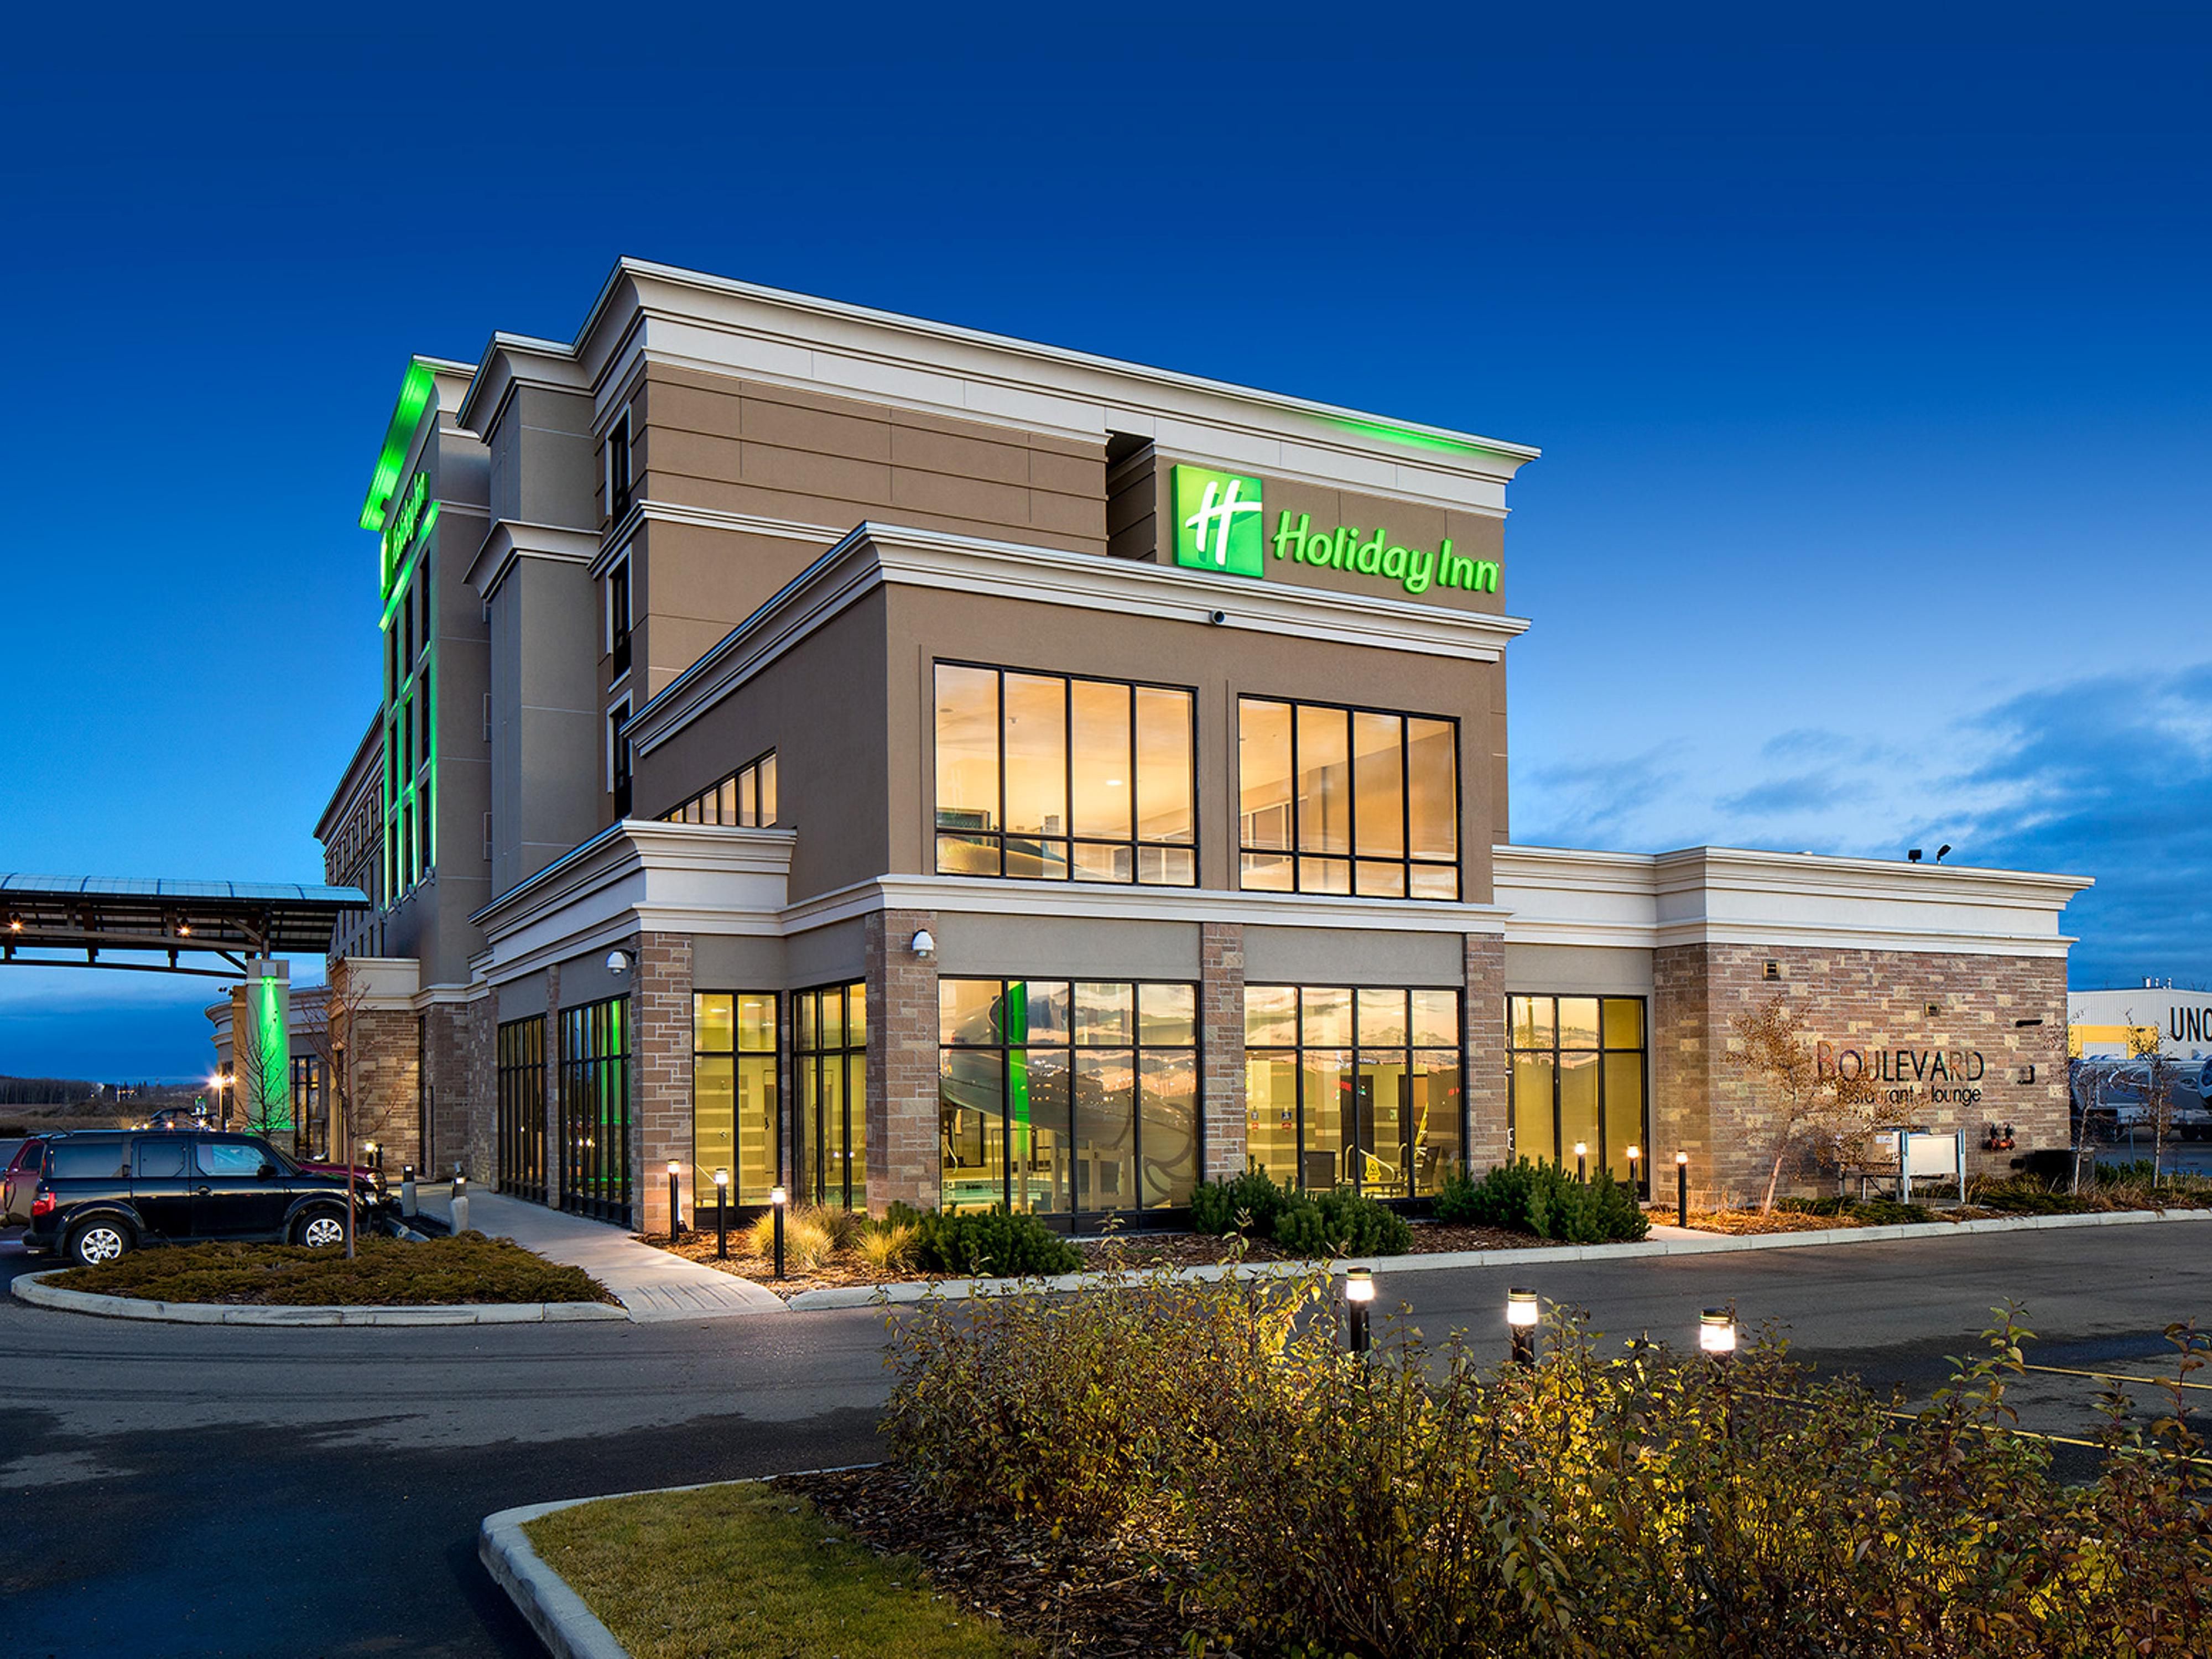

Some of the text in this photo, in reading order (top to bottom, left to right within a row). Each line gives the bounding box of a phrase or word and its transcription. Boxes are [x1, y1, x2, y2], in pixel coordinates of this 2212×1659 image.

[1272, 510, 1498, 593] Holiday Inn
[1817, 1040, 1985, 1082] BOULEVARD
[1931, 1085, 1981, 1106] lounge
